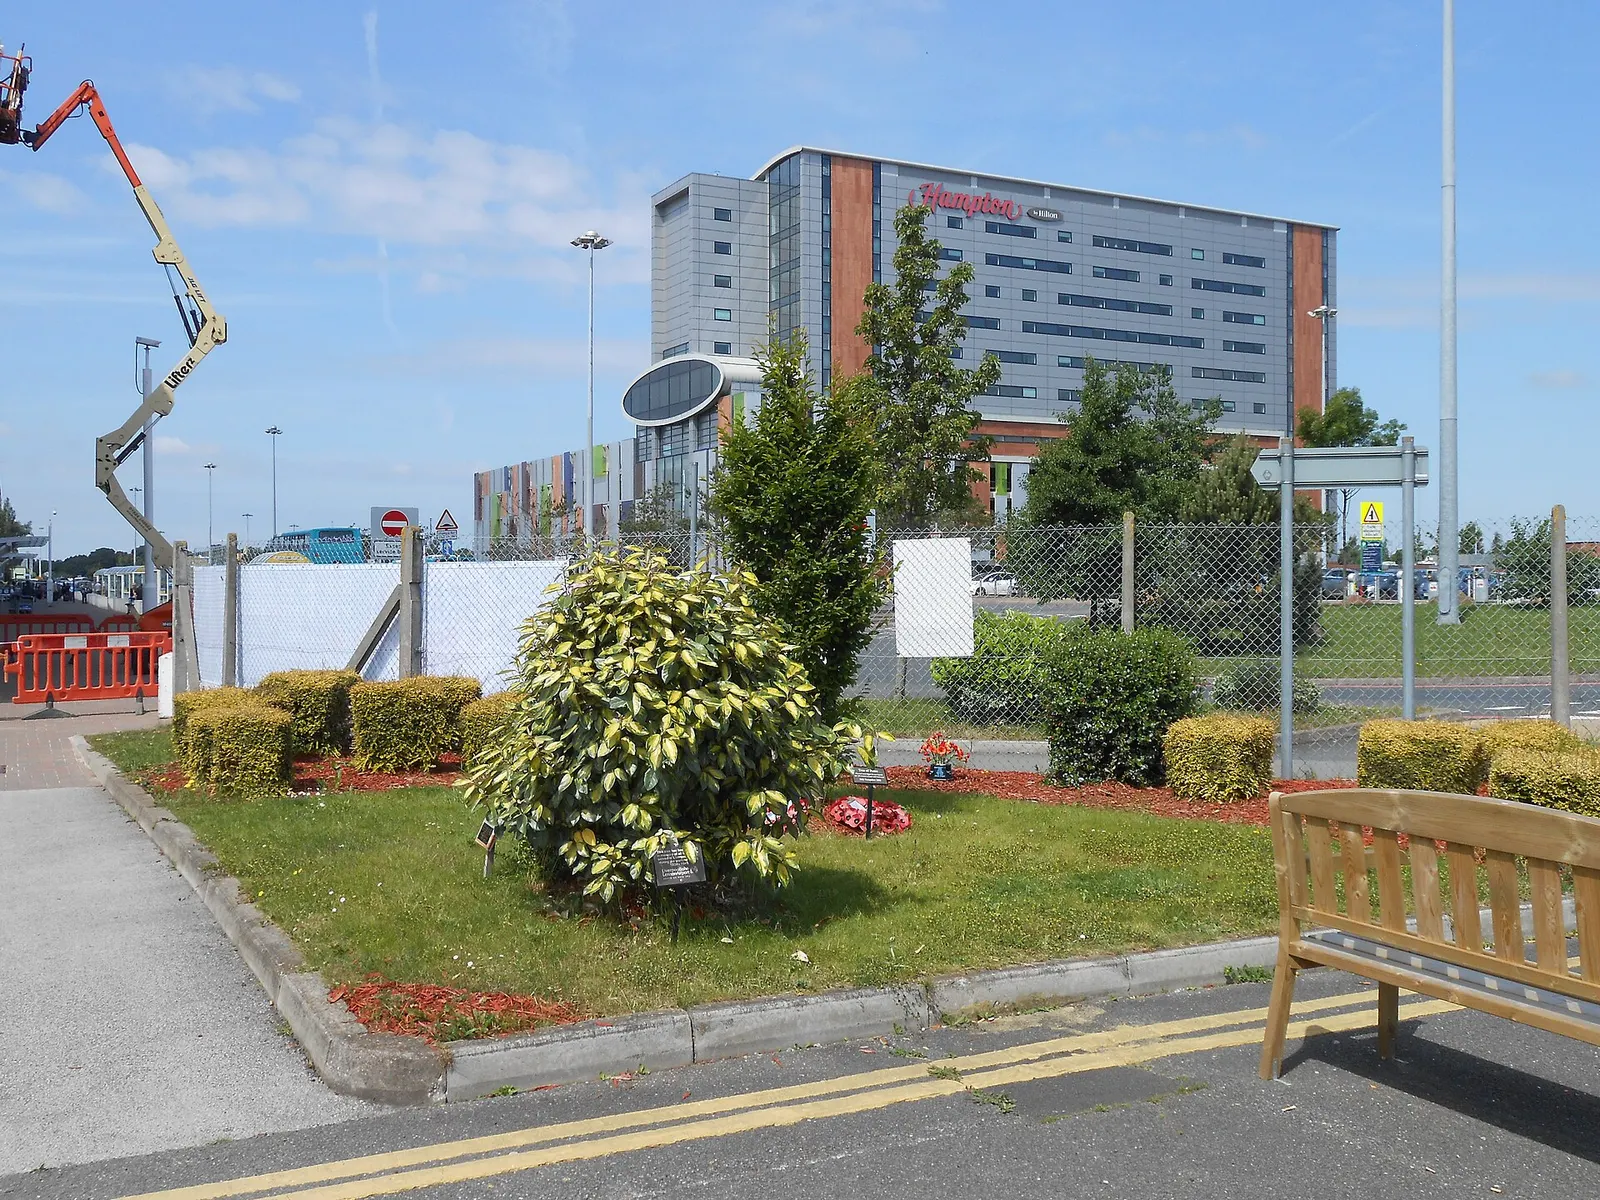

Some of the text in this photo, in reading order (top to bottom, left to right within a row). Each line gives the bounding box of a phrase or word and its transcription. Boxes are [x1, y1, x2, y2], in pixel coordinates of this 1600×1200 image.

[908, 182, 1022, 221] Hampton
[1039, 210, 1058, 219] Hilton
[164, 357, 195, 389] Lifterz
